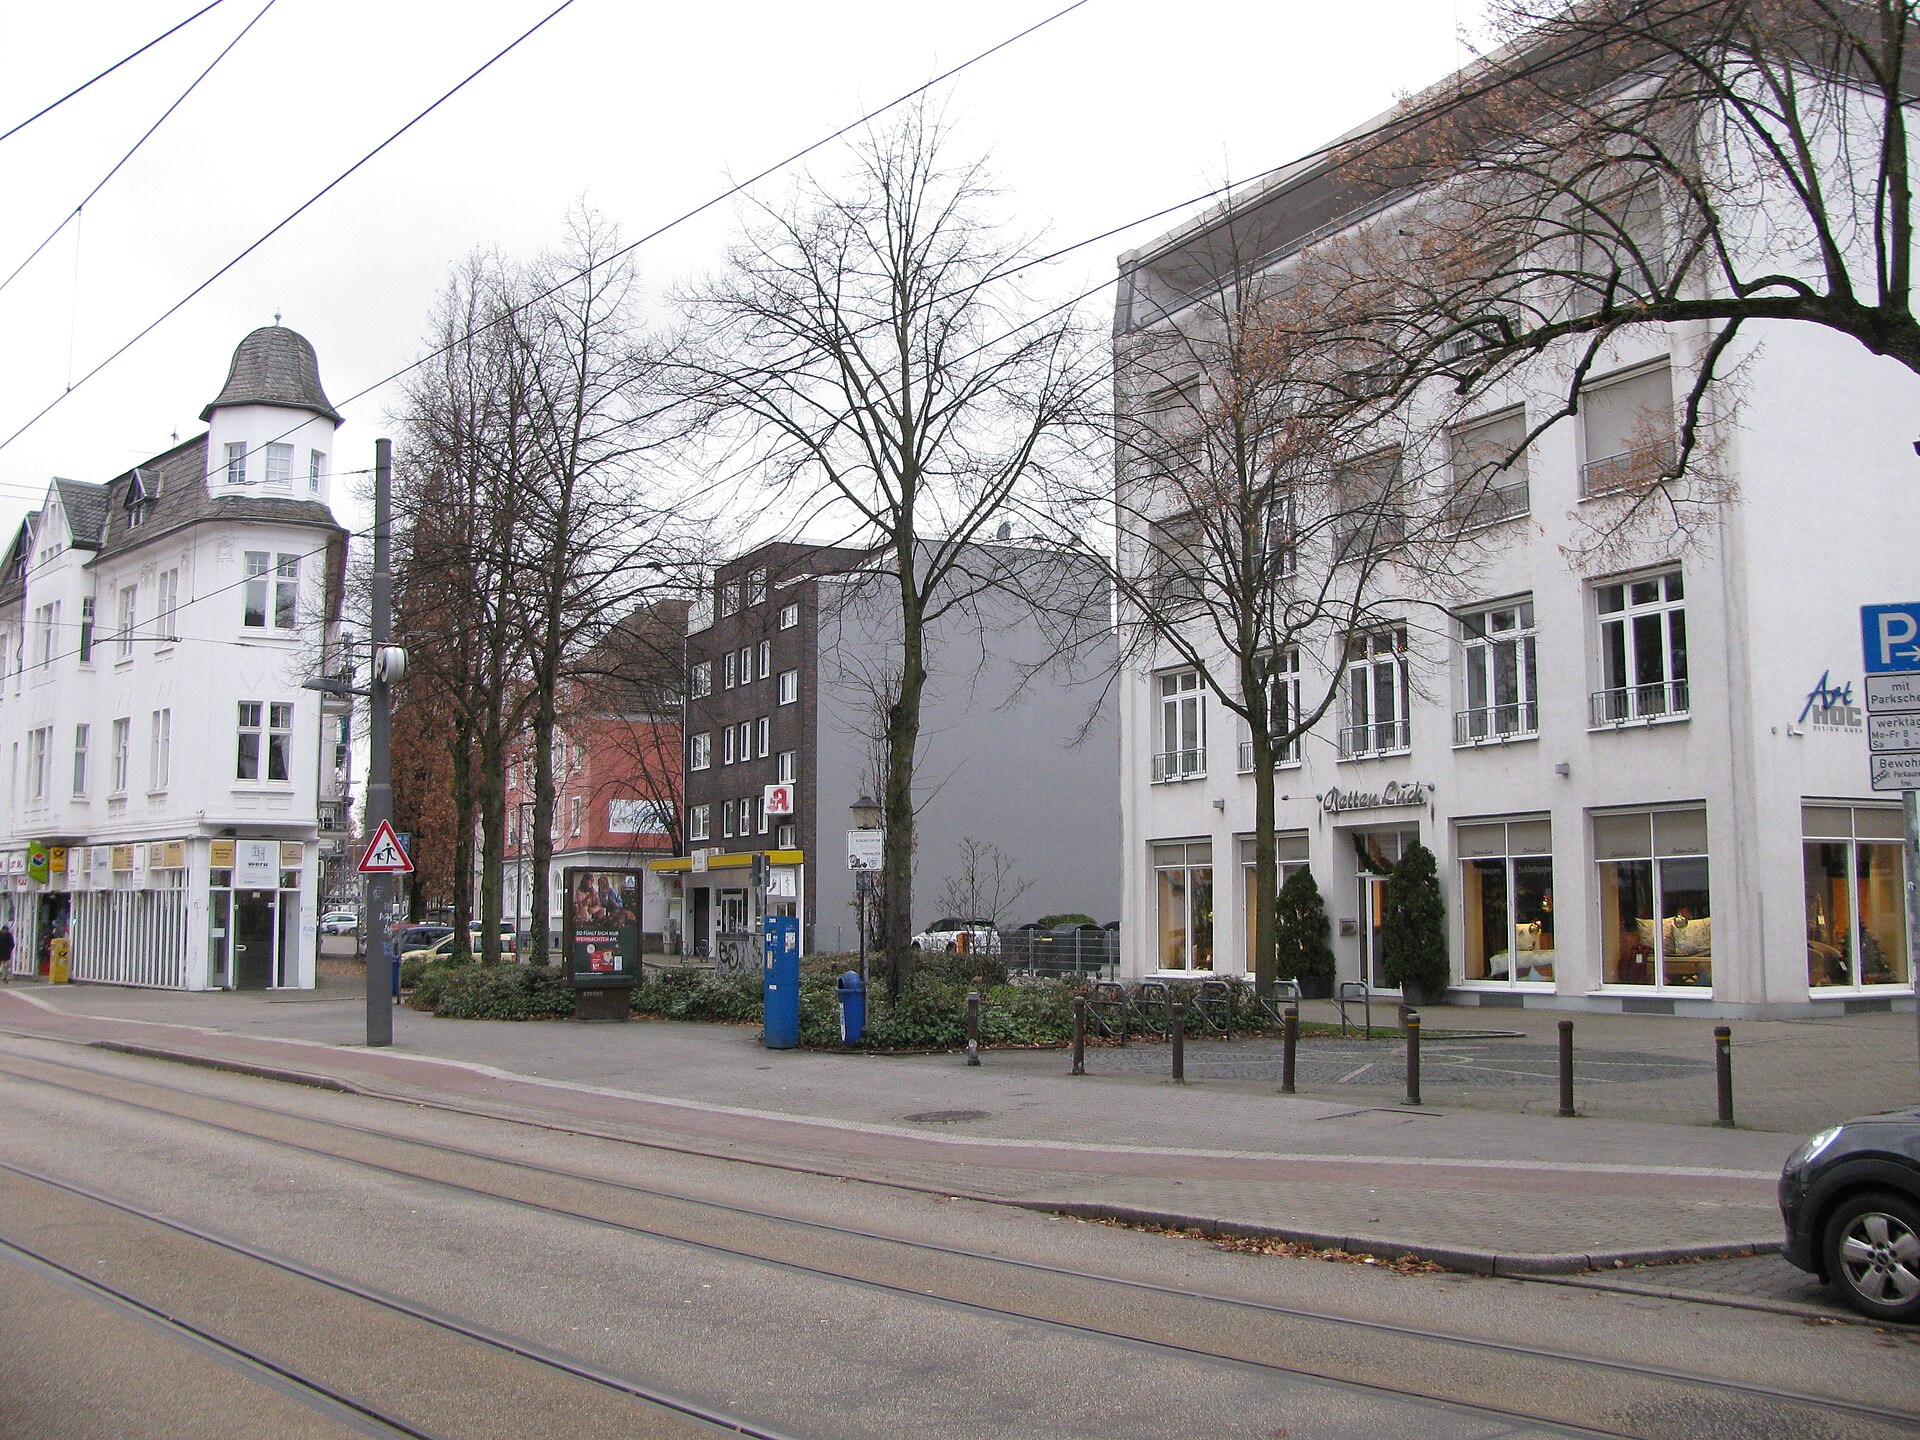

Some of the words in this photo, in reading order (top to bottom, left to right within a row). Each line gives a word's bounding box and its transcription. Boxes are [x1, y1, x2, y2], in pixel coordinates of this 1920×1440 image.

[1878, 612, 1917, 664] P
[1798, 669, 1853, 723] Art
[1892, 681, 1910, 691] mit
[1873, 740, 1884, 749] Sa
[1323, 785, 1380, 812] Rattan
[1381, 780, 1424, 806] Luck
